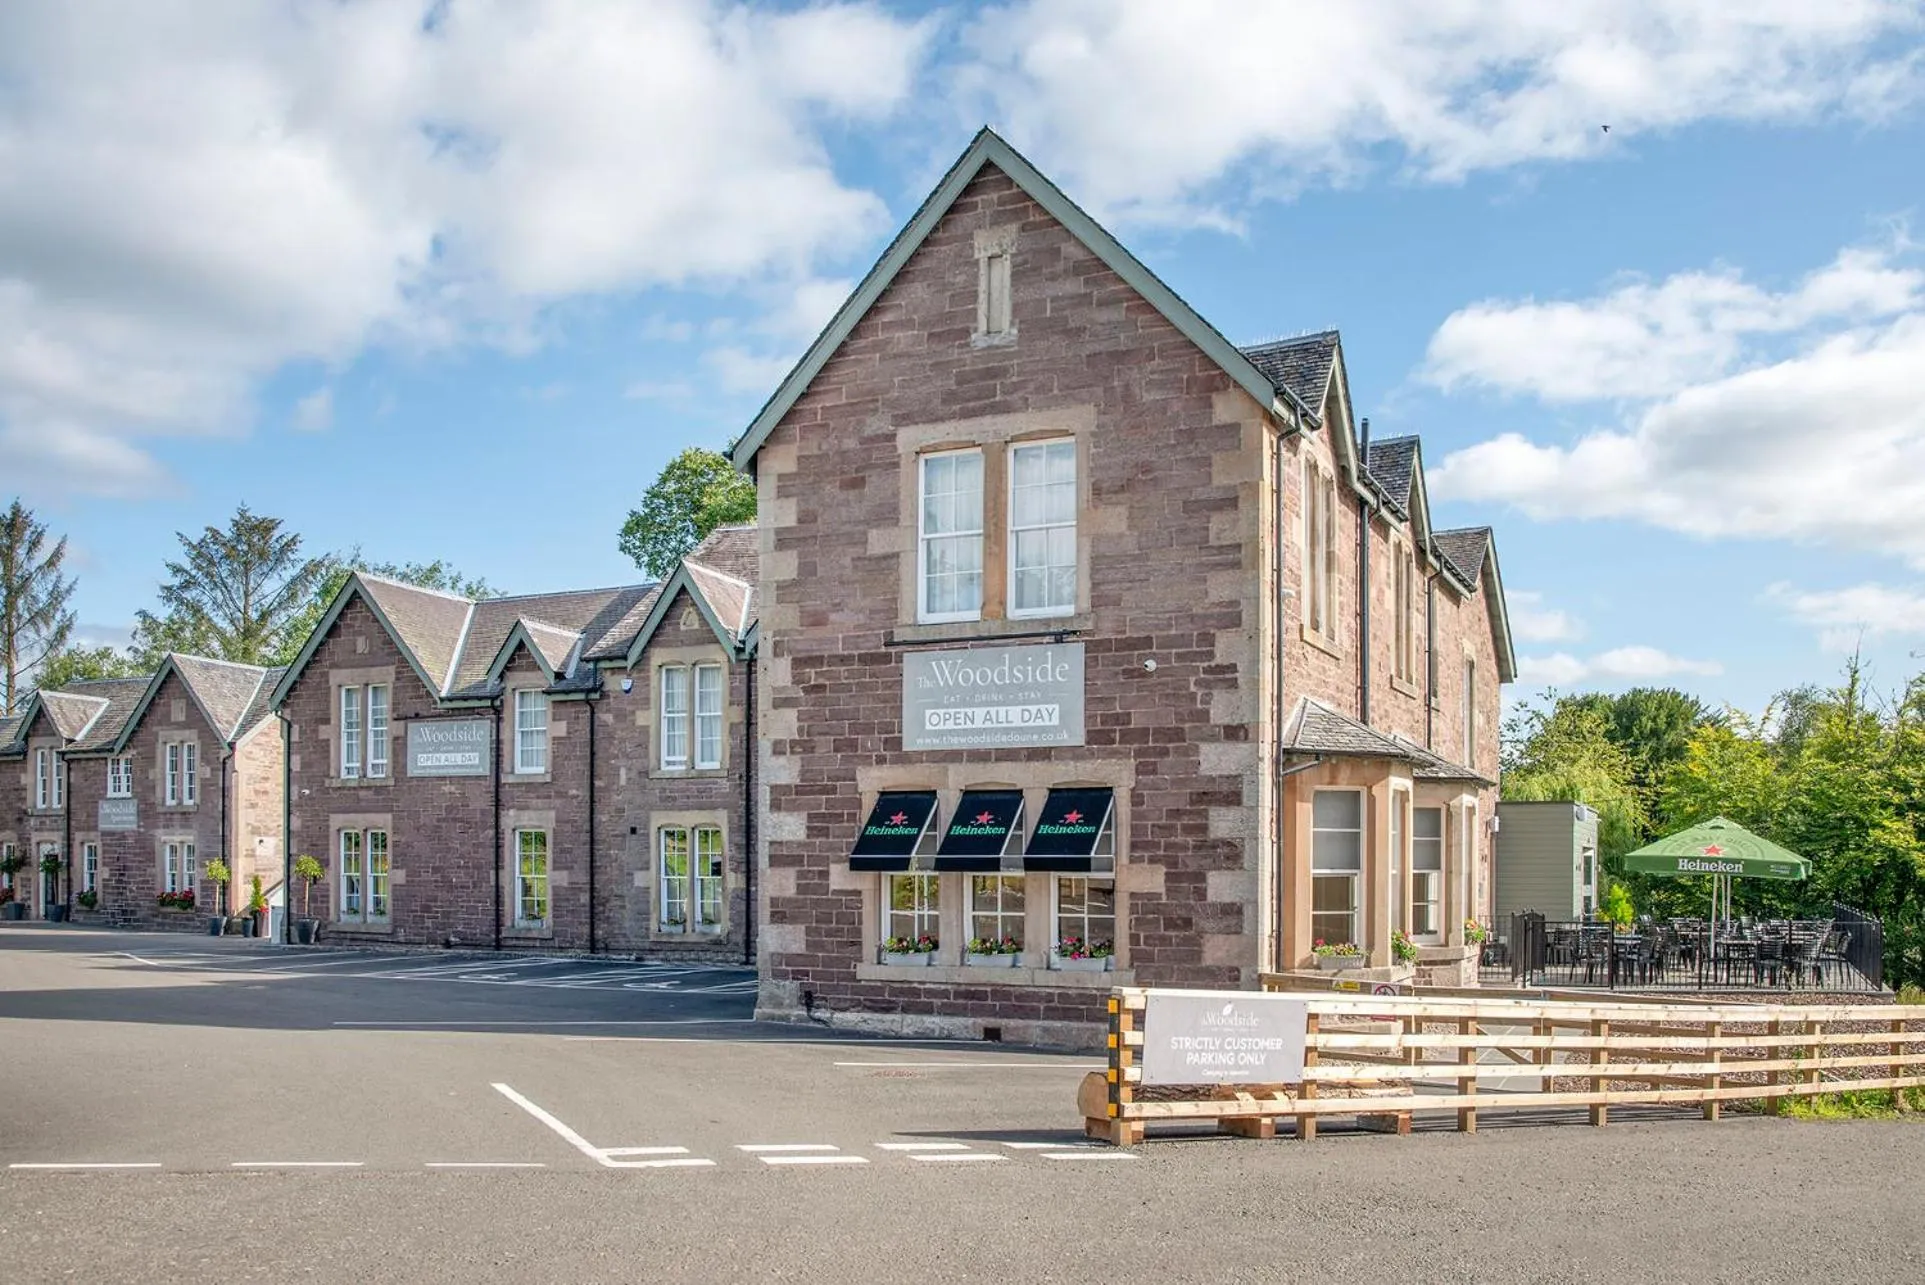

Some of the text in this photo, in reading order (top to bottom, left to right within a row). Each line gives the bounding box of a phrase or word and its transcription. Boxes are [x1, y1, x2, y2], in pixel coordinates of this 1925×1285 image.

[931, 652, 1070, 687] Woodside
[944, 691, 1042, 704] EAT DRINK STAY
[928, 707, 1056, 727] OPEN ALL DAY
[420, 724, 484, 742] Woodside
[915, 730, 1069, 746] www.thewoodsidedoune.co.uk
[865, 825, 919, 836] Heineken
[950, 825, 1006, 836] Heineken
[1037, 824, 1097, 835] Heineken
[1677, 858, 1744, 873] Heineken
[1170, 1037, 1283, 1051] STRICTLY CUSTOMER
[1186, 1051, 1267, 1066] PARKING ONLY
